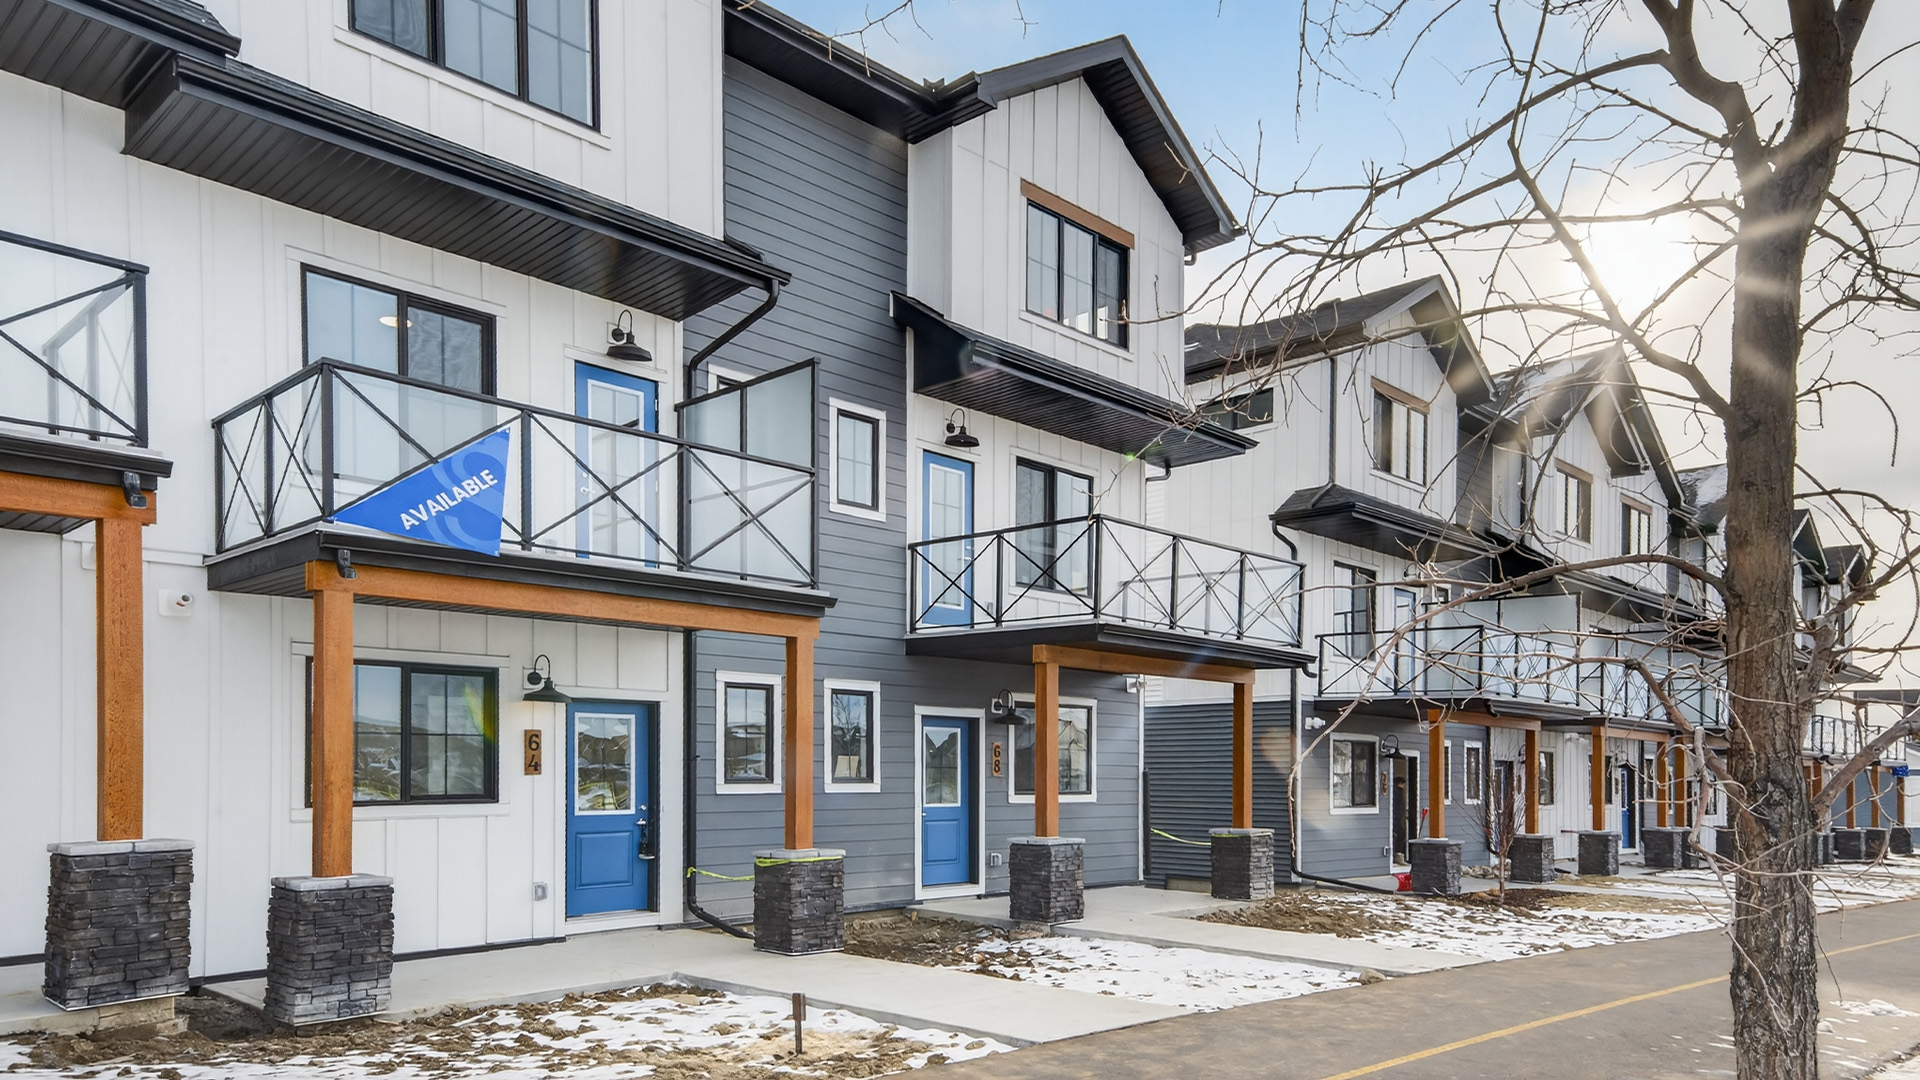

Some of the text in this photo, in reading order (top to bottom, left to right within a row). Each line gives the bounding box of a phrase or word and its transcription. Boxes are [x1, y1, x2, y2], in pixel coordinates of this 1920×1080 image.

[400, 470, 498, 530] AVAILABLE
[528, 733, 540, 772] 64
[993, 744, 1001, 773] 68
